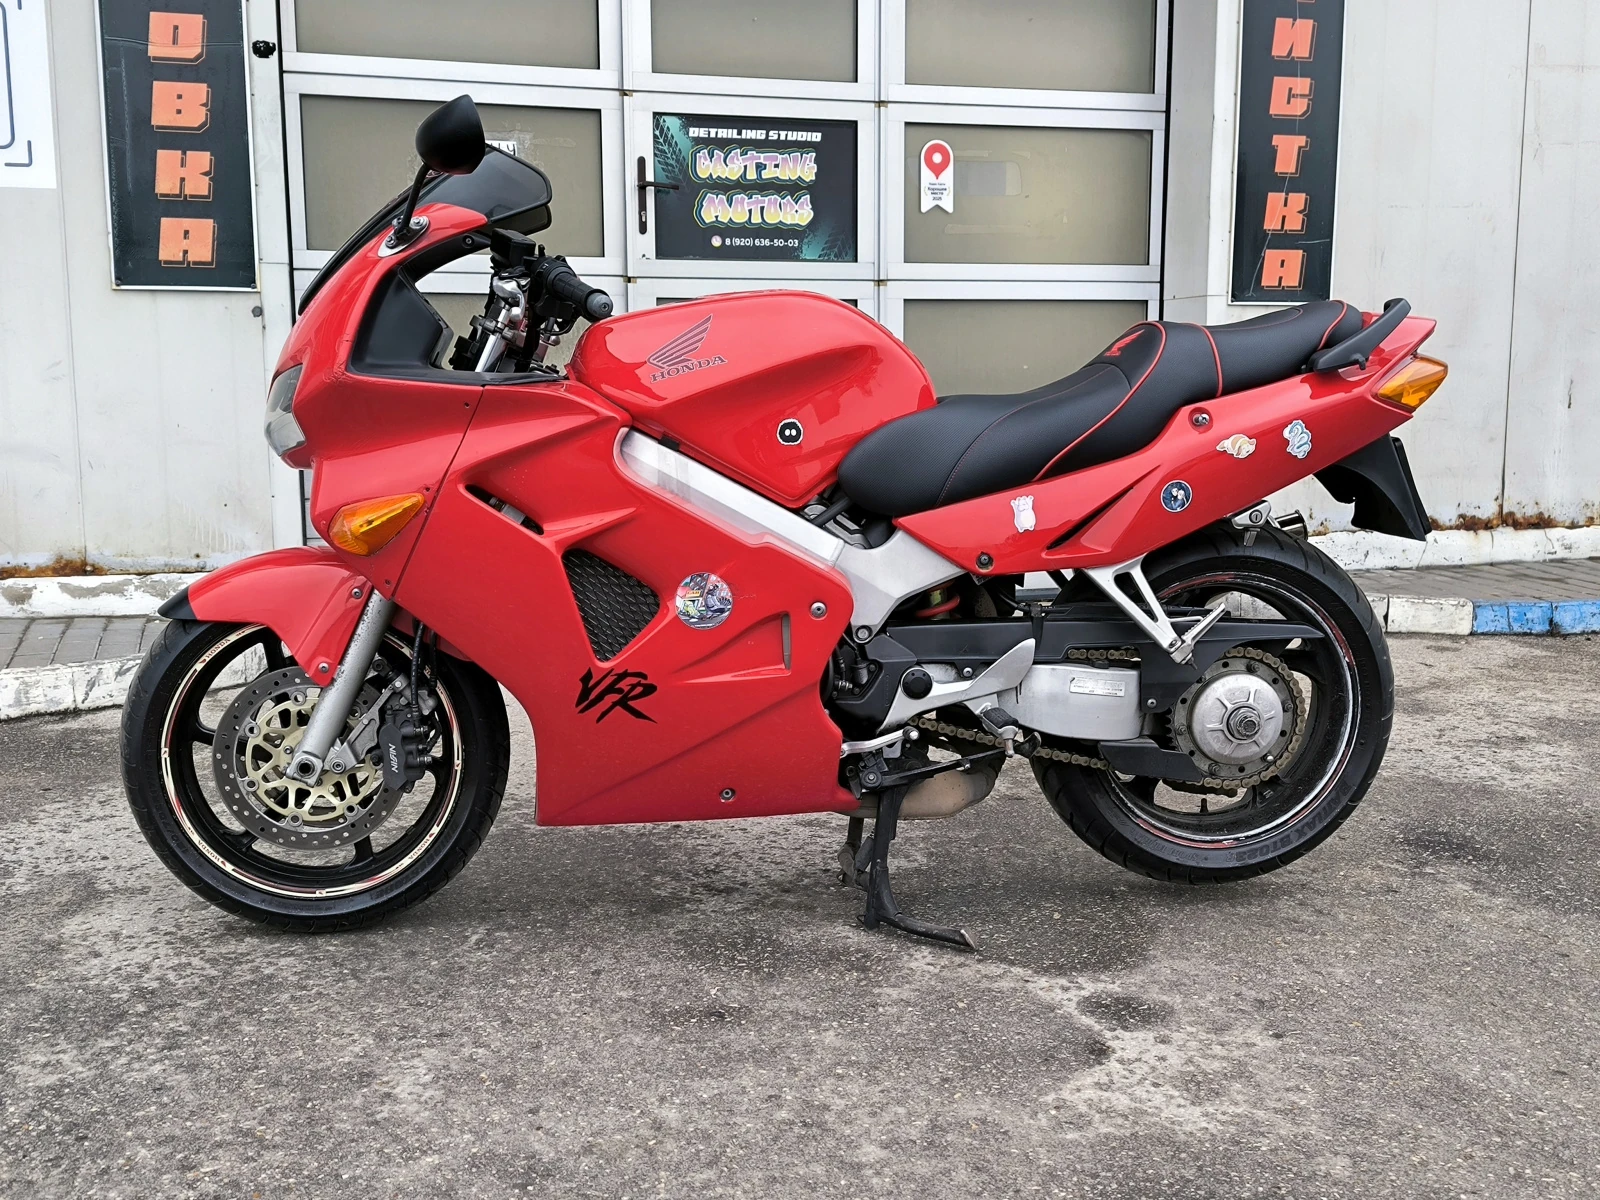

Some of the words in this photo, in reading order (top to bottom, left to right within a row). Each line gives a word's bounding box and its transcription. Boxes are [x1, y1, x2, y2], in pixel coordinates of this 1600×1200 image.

[689, 127, 766, 140] DETAILING
[768, 130, 822, 142] STUDIO
[693, 146, 817, 184] CASTING
[698, 191, 814, 227] MOTORS
[725, 238, 731, 246] 8
[732, 237, 753, 247] (920)
[754, 238, 799, 247] 636-50-03
[650, 355, 728, 384] HONDA
[205, 639, 230, 658] HONDA
[575, 667, 658, 724] VFR
